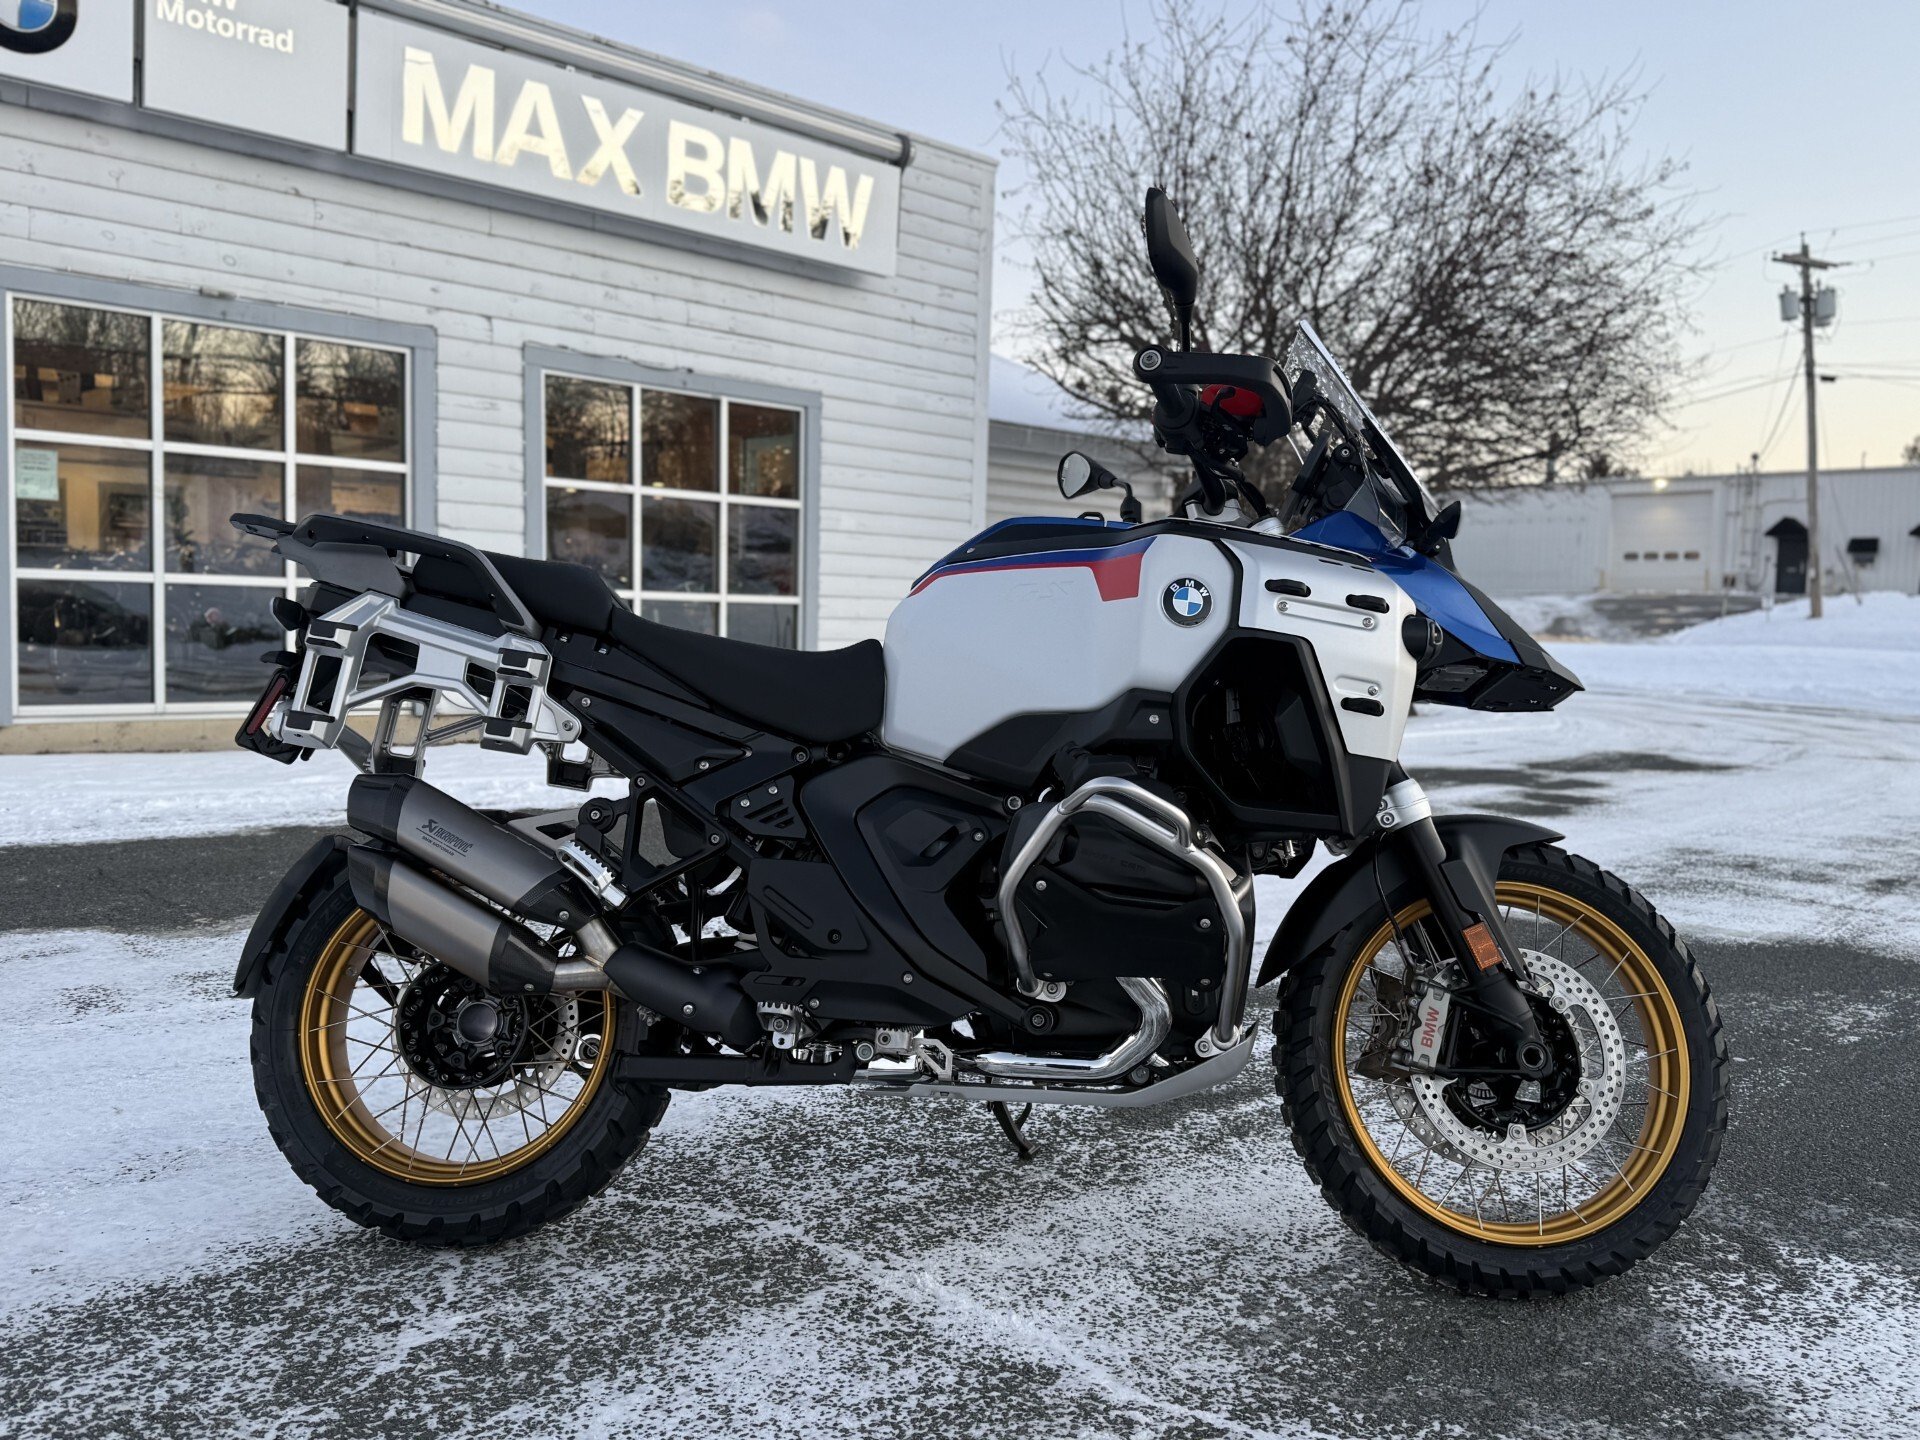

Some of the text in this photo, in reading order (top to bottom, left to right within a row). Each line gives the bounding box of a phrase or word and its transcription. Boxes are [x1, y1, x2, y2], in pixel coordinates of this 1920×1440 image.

[157, 0, 294, 54] Motorrad
[401, 46, 874, 251] MAX BMW
[1170, 579, 1210, 597] BMW
[1420, 1005, 1440, 1048] BMW
